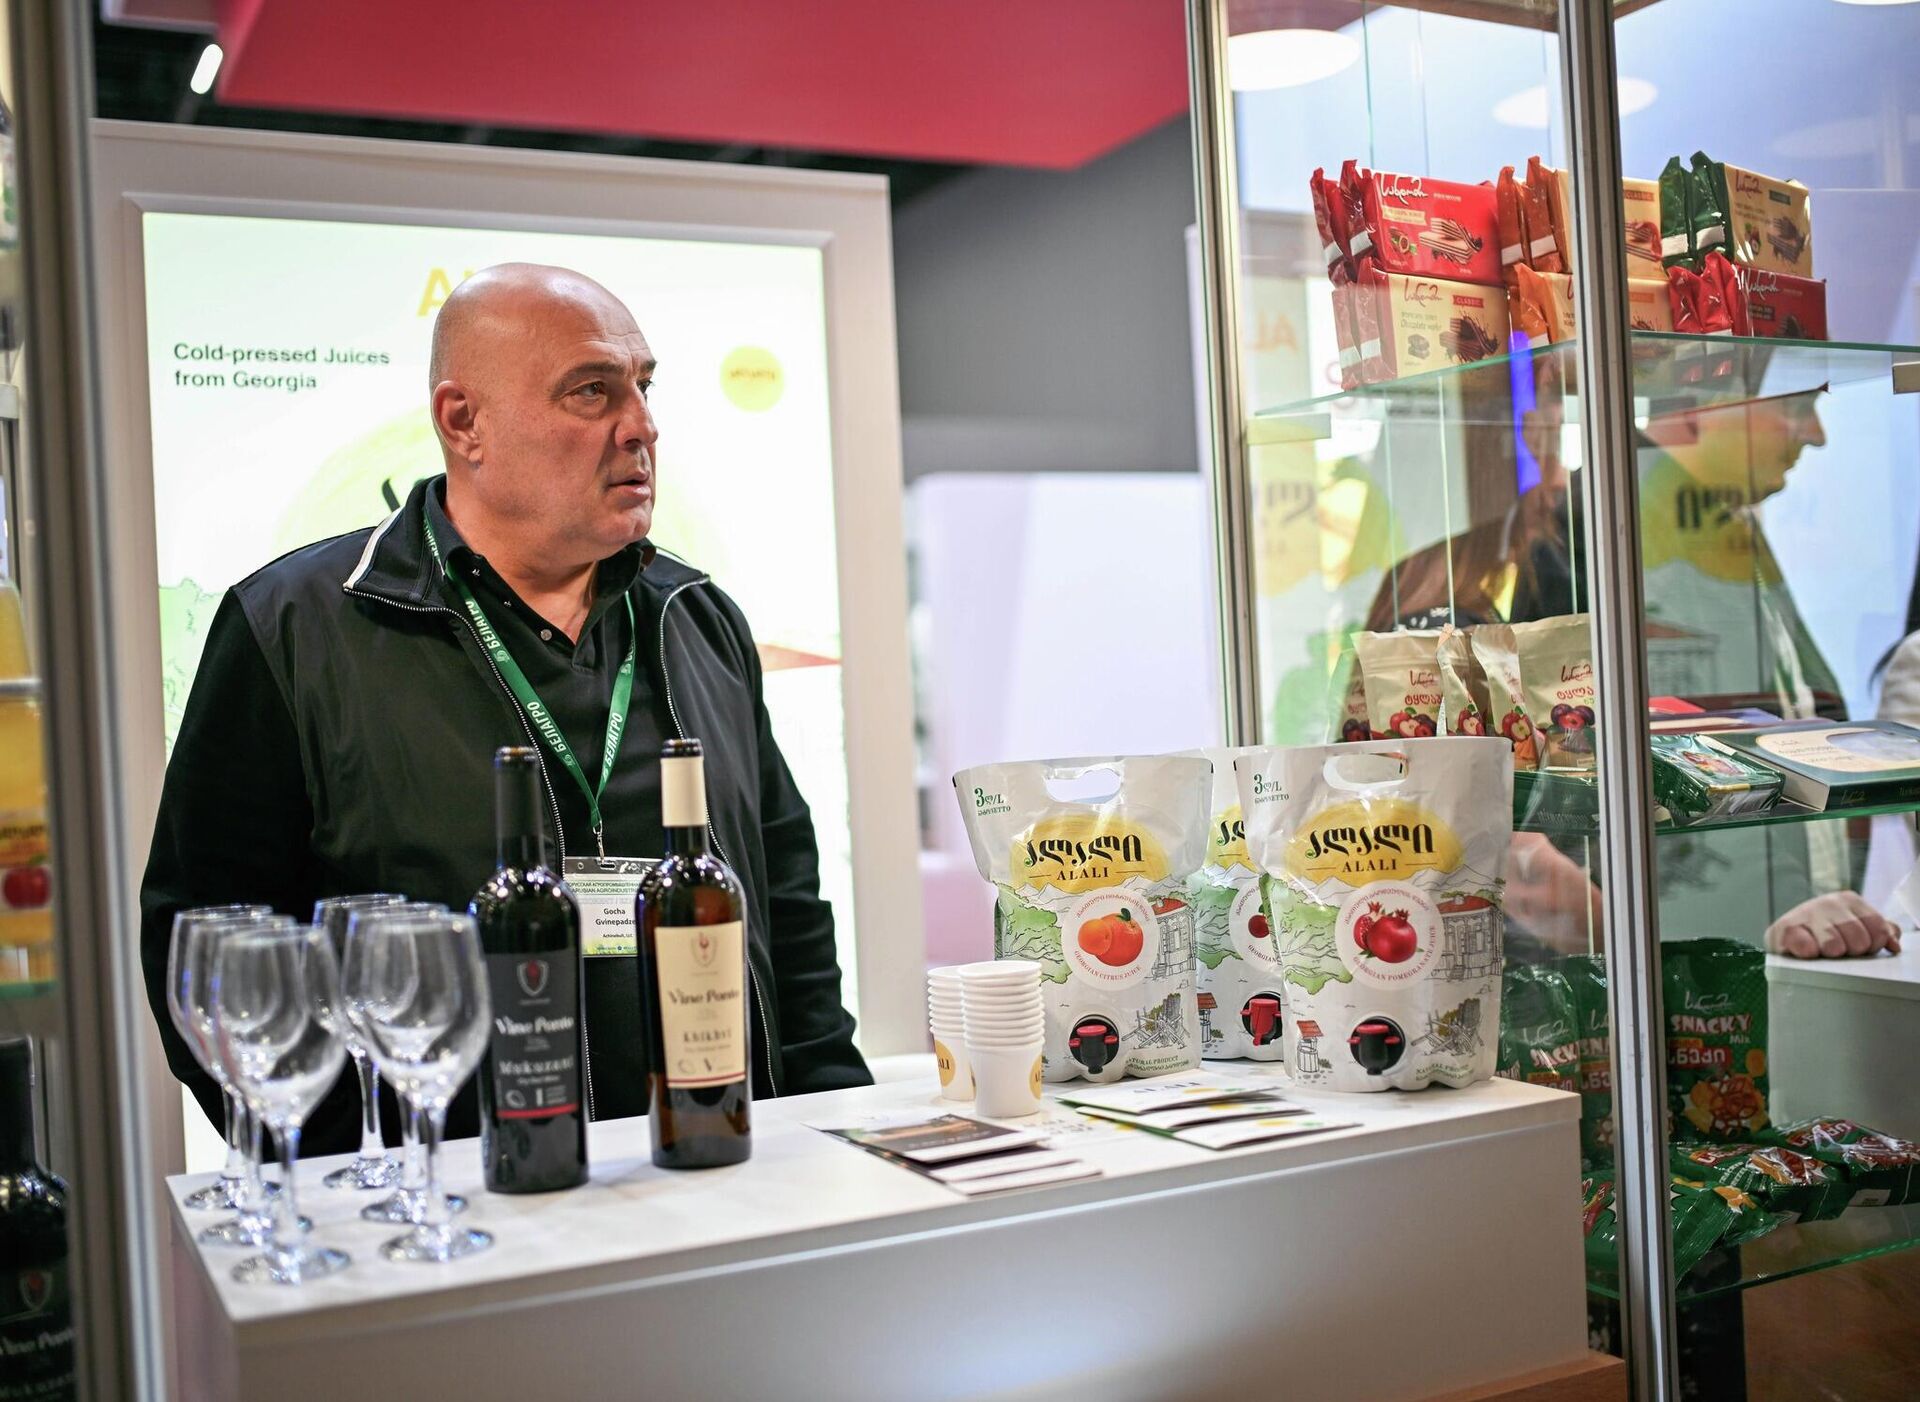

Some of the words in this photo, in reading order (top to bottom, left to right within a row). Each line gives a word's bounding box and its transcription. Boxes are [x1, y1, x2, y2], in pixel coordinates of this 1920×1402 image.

[173, 343, 317, 365] Cold-pressed
[324, 347, 390, 364] Juices
[174, 370, 225, 387] from
[232, 371, 317, 392] Georgia
[526, 701, 567, 753] БЕЛАГРО
[604, 712, 624, 769] БЕЛАГРО
[1056, 867, 1110, 881] ALALI
[1341, 858, 1398, 874] ALALI
[595, 918, 636, 926] Gvinepadze
[603, 907, 626, 915] Gocha
[1074, 950, 1099, 977] GEORGIAN
[1124, 965, 1142, 978] JUICE
[1670, 1013, 1753, 1034] SNACKY
[1530, 1041, 1579, 1067] SNACK
